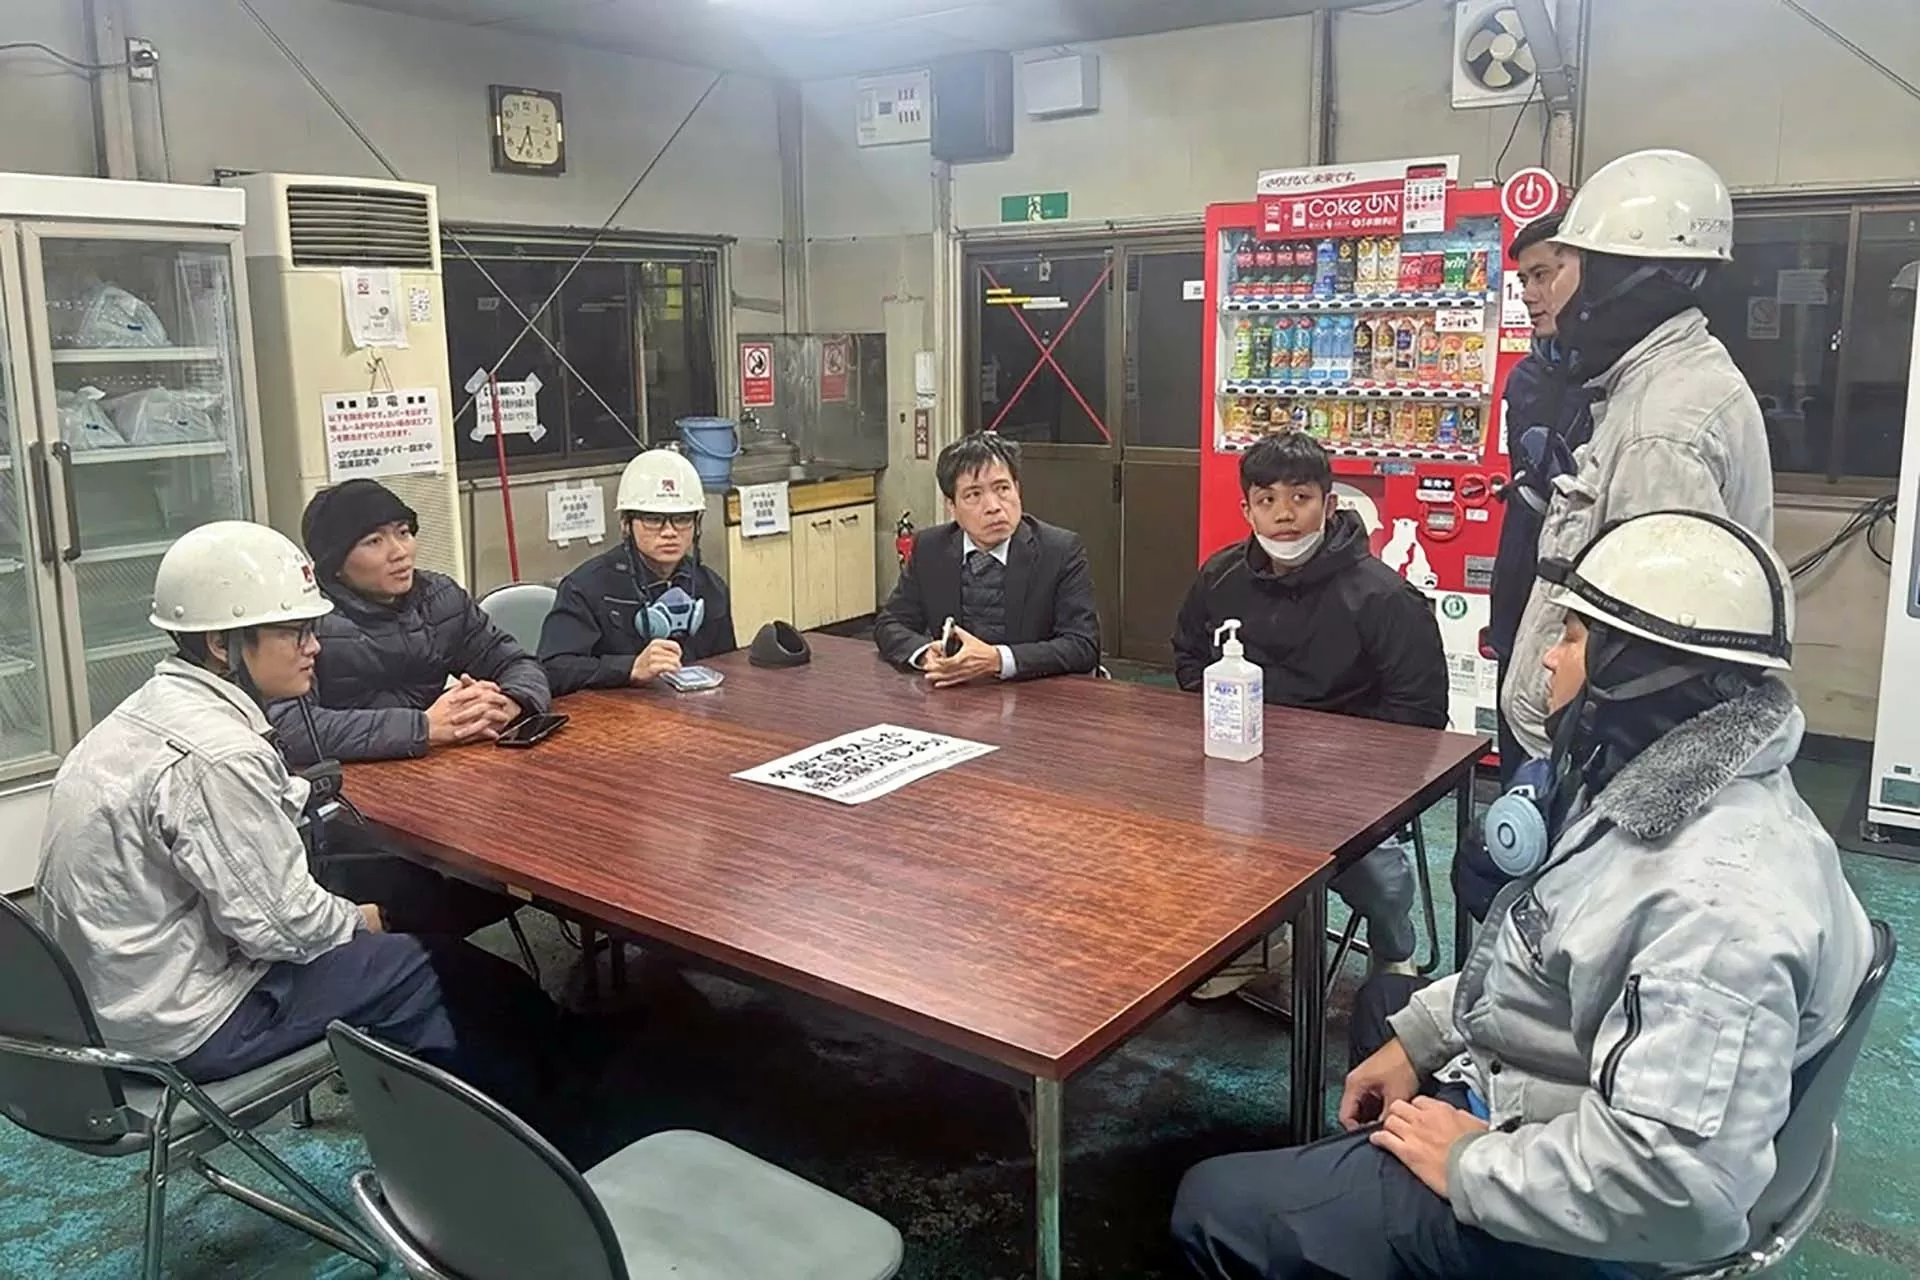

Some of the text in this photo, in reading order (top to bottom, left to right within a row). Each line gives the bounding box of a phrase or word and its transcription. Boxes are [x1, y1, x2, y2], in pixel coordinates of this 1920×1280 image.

[504, 109, 514, 119] 10
[542, 113, 549, 123] 2
[545, 127, 552, 137] 3
[1308, 193, 1399, 217] Coke ON
